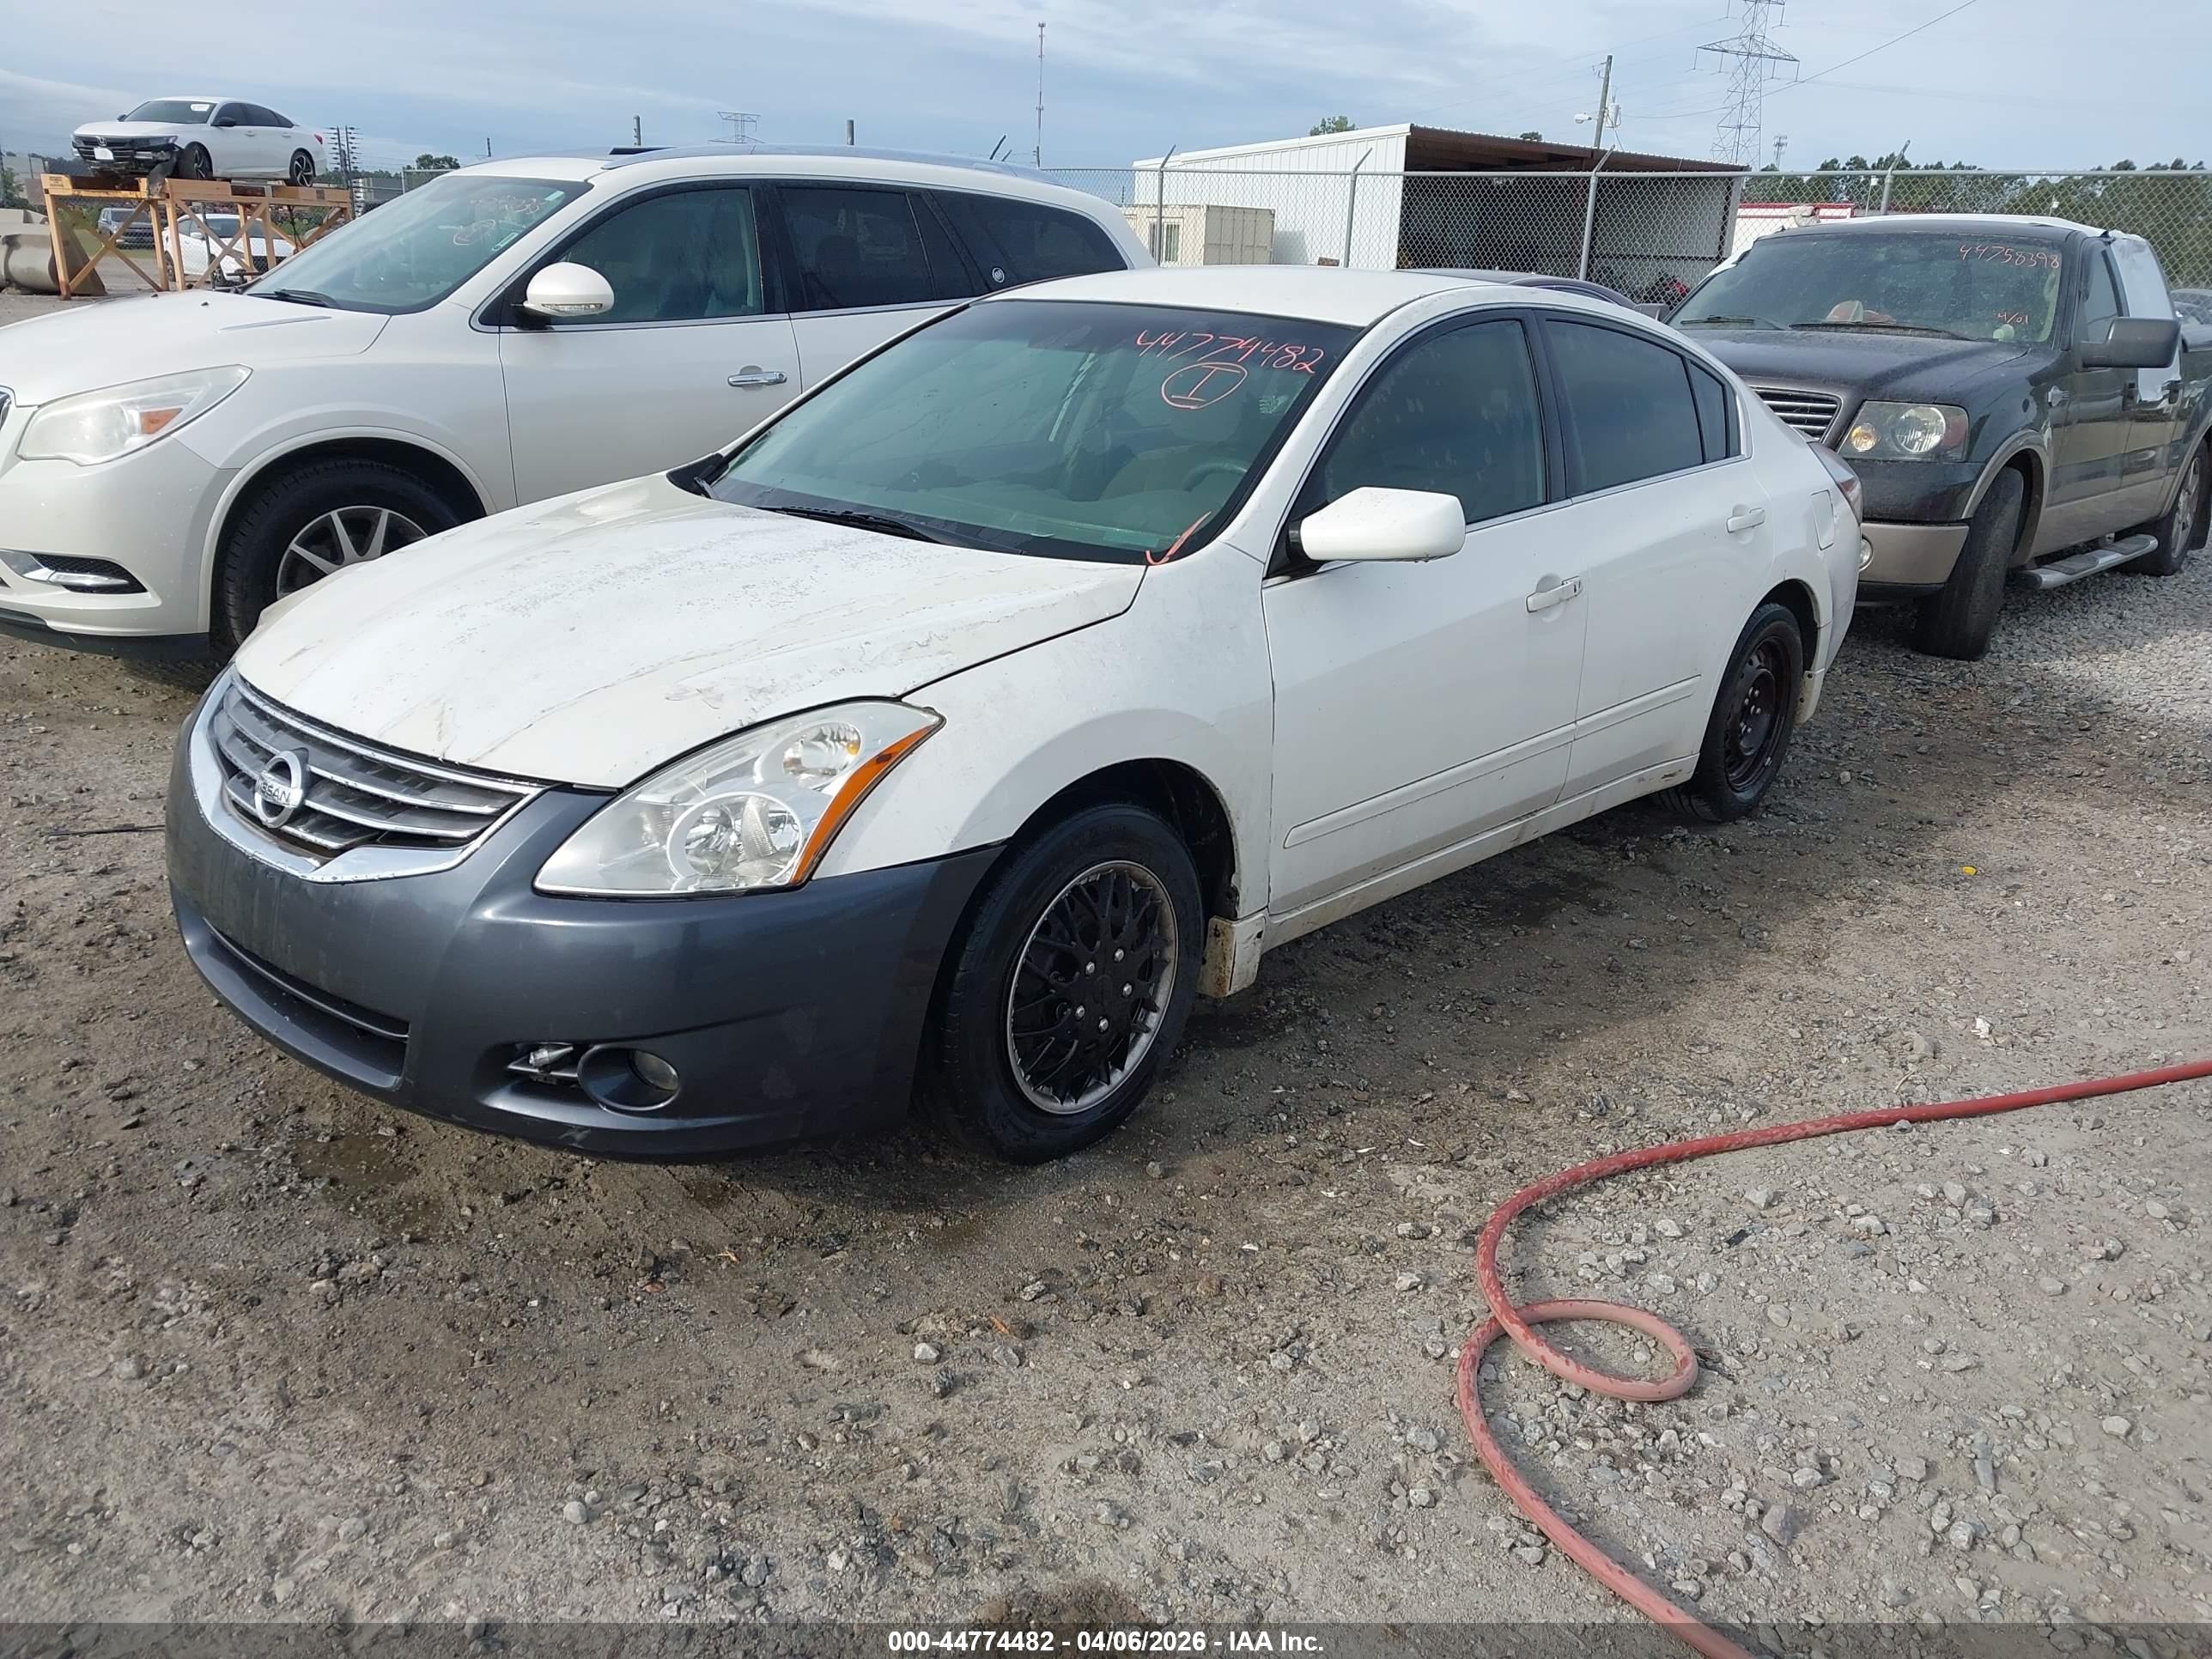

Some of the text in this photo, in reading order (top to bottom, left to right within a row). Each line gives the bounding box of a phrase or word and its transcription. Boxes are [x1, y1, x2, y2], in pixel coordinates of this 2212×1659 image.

[1960, 245, 2060, 269] 44758398
[1136, 329, 1325, 374] 44774482
[258, 781, 291, 803] SSAN
